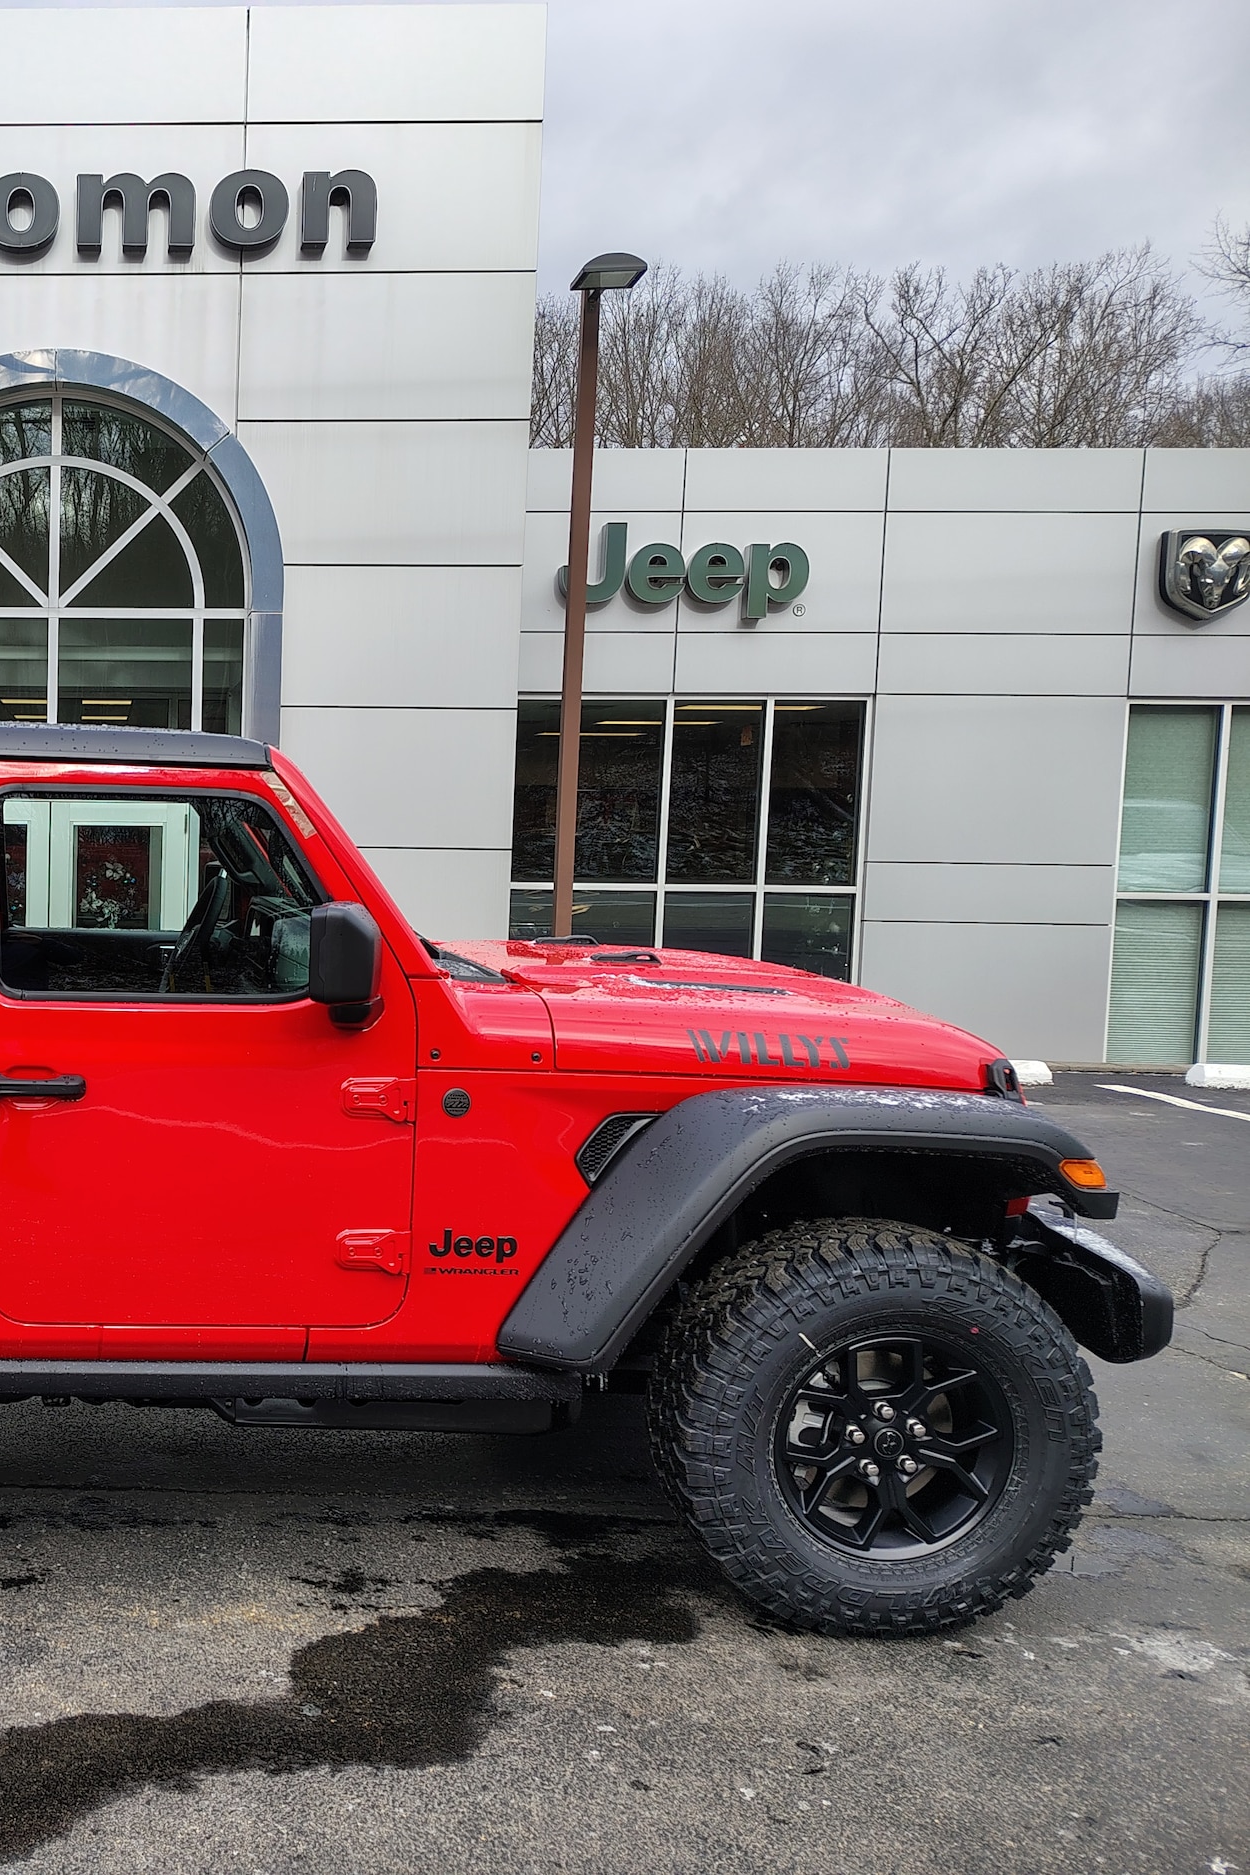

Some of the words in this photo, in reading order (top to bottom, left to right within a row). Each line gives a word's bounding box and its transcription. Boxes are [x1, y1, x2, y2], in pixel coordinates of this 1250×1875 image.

[558, 522, 810, 619] Jeep
[686, 1029, 850, 1069] WILLYS
[428, 1228, 518, 1264] Jeep
[438, 1267, 519, 1275] WRANGLER
